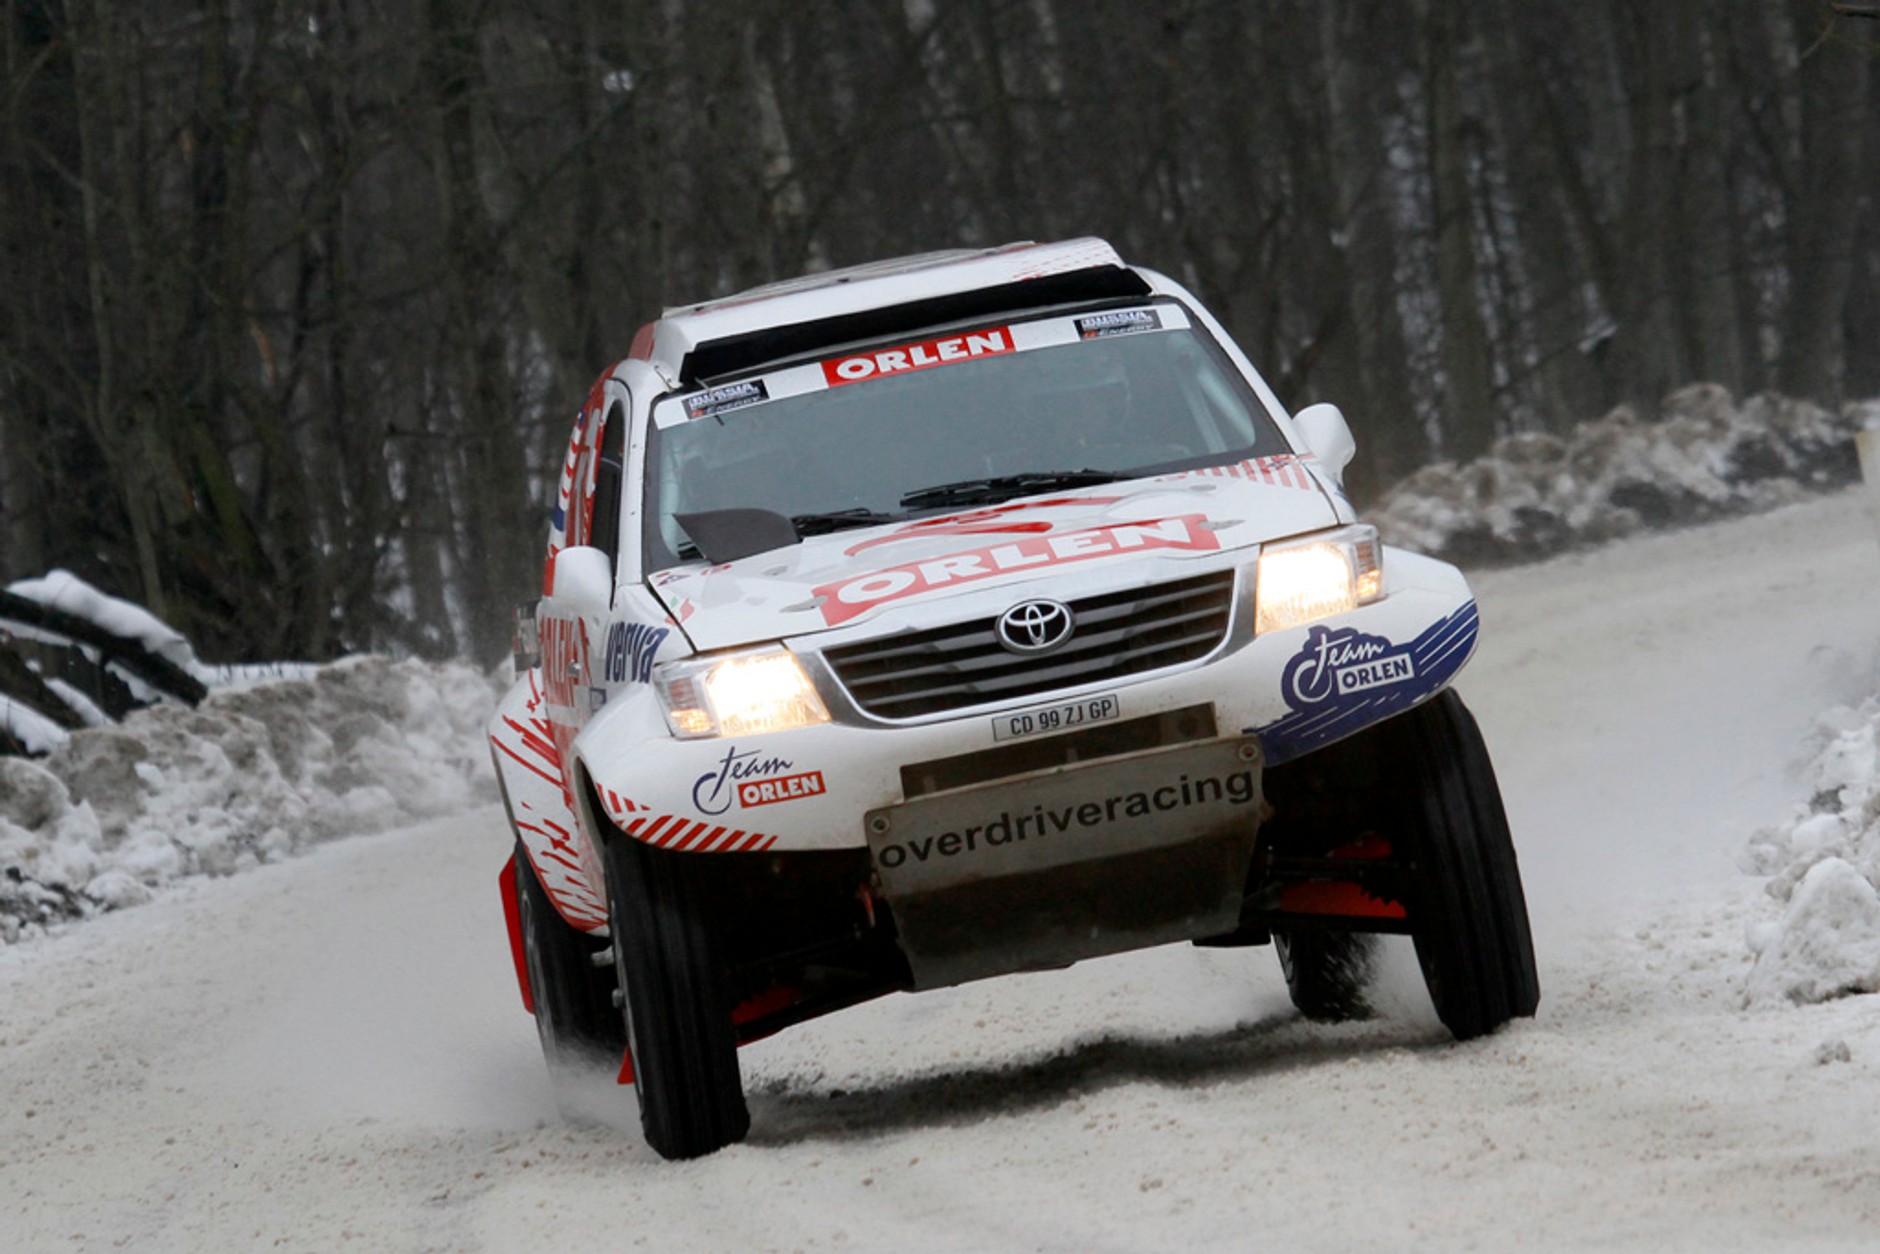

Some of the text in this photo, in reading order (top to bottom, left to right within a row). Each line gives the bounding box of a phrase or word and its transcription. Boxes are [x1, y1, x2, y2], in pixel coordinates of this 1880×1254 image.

[836, 330, 1006, 380] ORLEN
[836, 518, 1196, 603] ORLEN
[604, 620, 670, 684] verva
[1307, 632, 1386, 690] team
[1341, 657, 1410, 689] ORLEN
[1010, 699, 1112, 736] CD 99 ZJ GP
[709, 746, 794, 802] team
[742, 774, 821, 804] ORLEN
[878, 769, 1255, 869] overdriveracing
